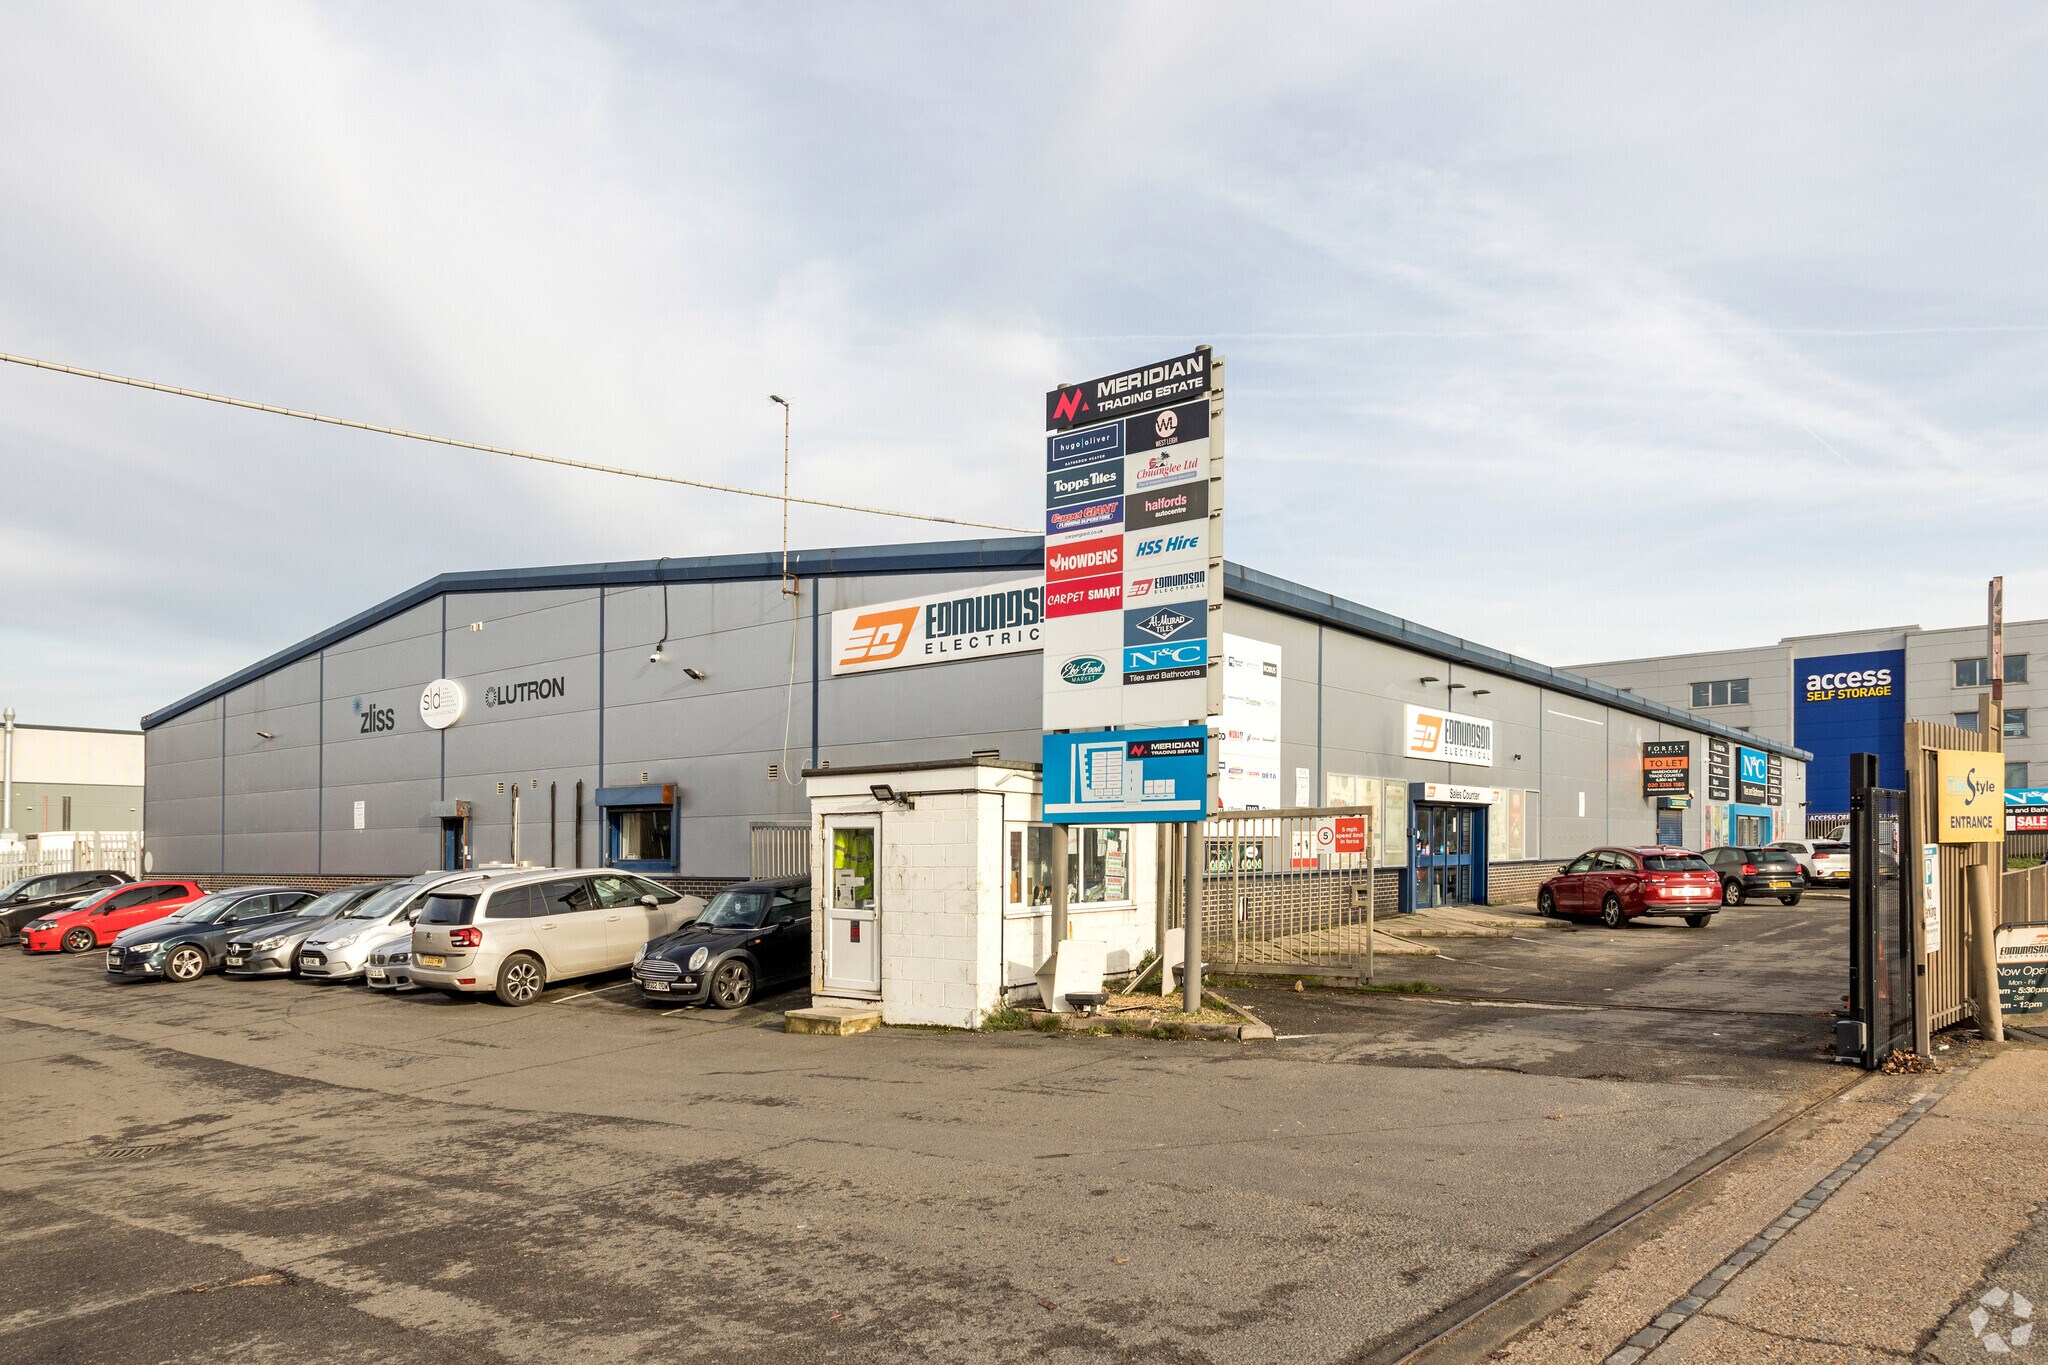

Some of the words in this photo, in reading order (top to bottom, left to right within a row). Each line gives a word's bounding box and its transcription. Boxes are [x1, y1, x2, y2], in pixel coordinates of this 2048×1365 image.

[1097, 355, 1204, 398] MERIDIAN
[1097, 391, 1153, 413] TRADING
[1155, 376, 1204, 398] ESTATE
[1184, 457, 1199, 470] Ltd
[1053, 477, 1089, 492] Topps
[1090, 471, 1117, 484] Tiles
[1144, 494, 1187, 512] halfords
[1051, 510, 1083, 523] Carpet
[1083, 502, 1118, 518] GIANT
[1154, 506, 1187, 518] autocentre
[1064, 528, 1104, 540] carpetgiant.co.uk
[1136, 539, 1163, 557] HSS
[1165, 535, 1199, 552] Hire
[1060, 548, 1118, 571] HOWDENS
[1154, 570, 1205, 589] EDMUNDSON
[1047, 591, 1085, 606] CARPET
[1088, 585, 1121, 601] SMART
[1154, 583, 1205, 594] ELECTRICAL
[925, 585, 1044, 640] EDMUNDS
[1156, 624, 1174, 633] TILES
[924, 627, 1040, 655] ELECTRIC
[1129, 645, 1201, 668] N&C
[1129, 673, 1145, 682] Tiles
[1146, 672, 1160, 681] and
[1161, 668, 1200, 679] Bathrooms
[1806, 668, 1892, 691] access
[423, 686, 441, 711] sld
[497, 676, 565, 706] LUTRON
[1806, 690, 1836, 702] SELF
[1837, 685, 1892, 699] STORAGE
[360, 703, 395, 734] zliss
[1444, 718, 1490, 750] EDMUNDSON
[1150, 741, 1200, 751] MERIDIAN
[1151, 748, 1177, 756] TRADING
[1177, 747, 1199, 755] ESTATE
[1445, 747, 1490, 760] ELECTRICAL
[1649, 759, 1663, 767] TO
[1666, 759, 1684, 767] LET
[1743, 755, 1765, 779] N&C
[1261, 772, 1277, 780] DETA
[1449, 788, 1462, 800] Sales
[1462, 789, 1481, 801] Counter
[1809, 814, 1837, 822] ACCESS
[1950, 815, 1993, 829] ENTRANCE
[2017, 816, 2047, 827] SALE
[1323, 832, 1329, 840] 5
[2019, 1001, 2043, 1009] 12pm
